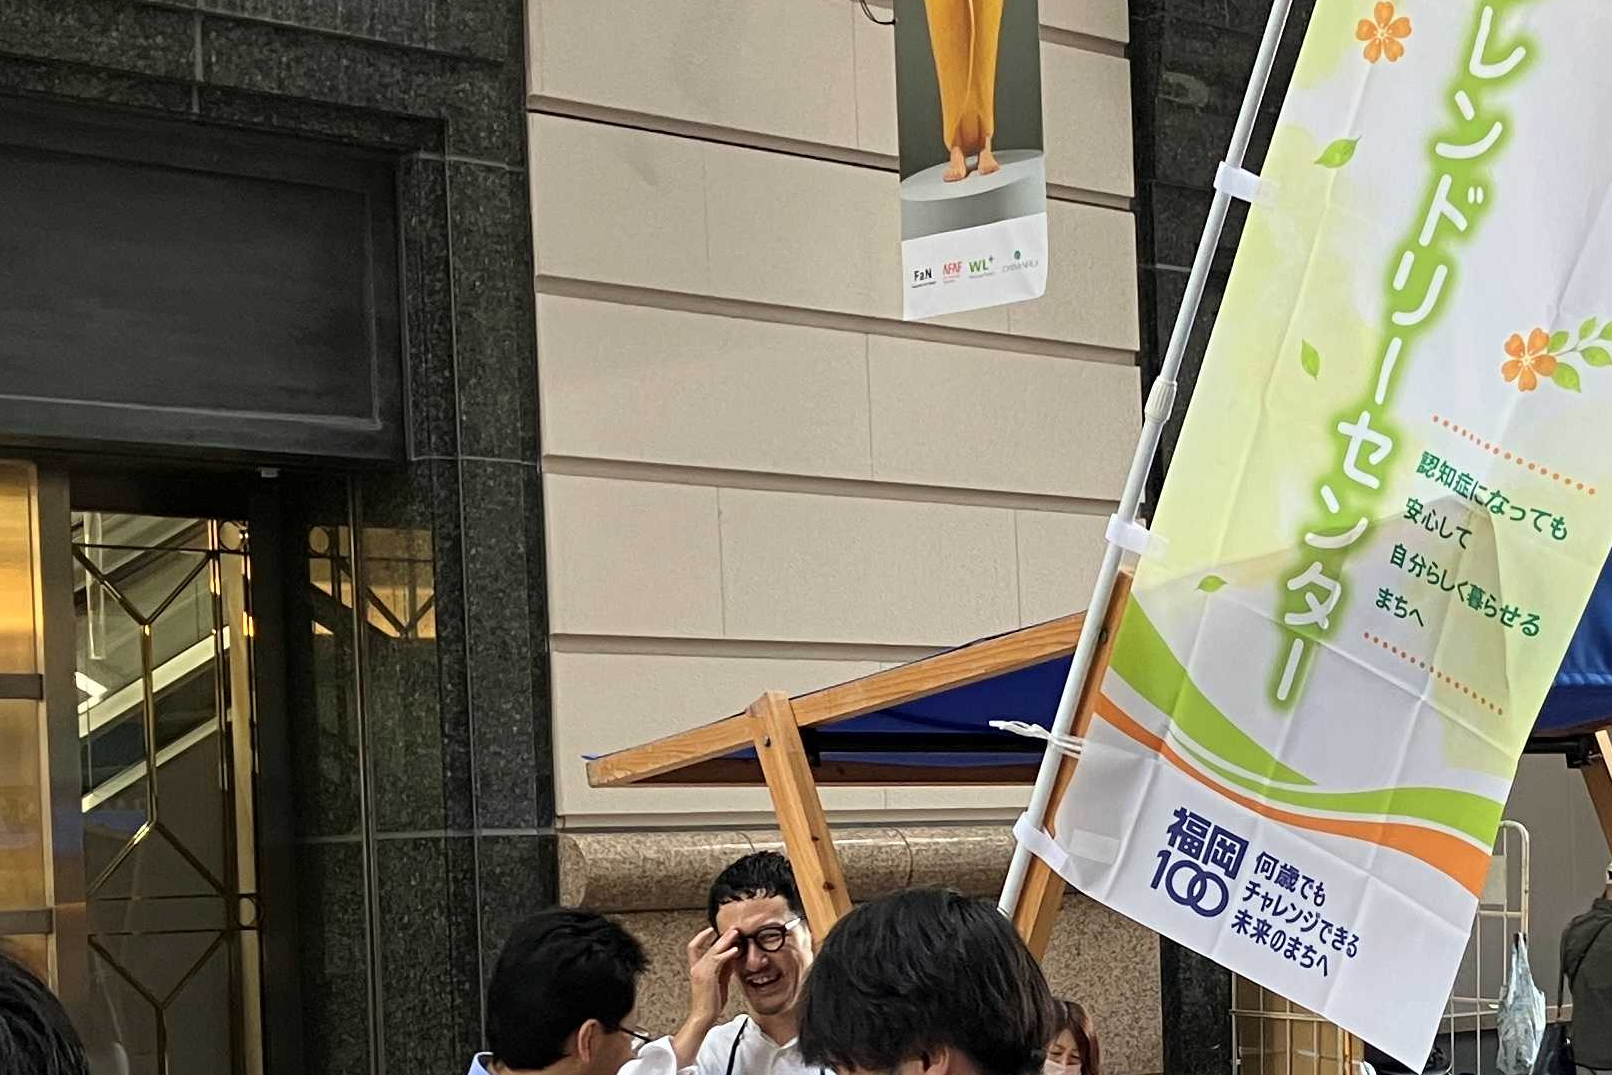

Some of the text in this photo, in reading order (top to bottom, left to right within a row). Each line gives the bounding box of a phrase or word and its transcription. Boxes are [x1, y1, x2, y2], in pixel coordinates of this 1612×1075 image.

[913, 267, 932, 282] FaN
[1403, 497, 1472, 549] 安心して
[1416, 451, 1568, 541] 認知症になっても
[1375, 587, 1425, 627] まちへ
[1390, 543, 1541, 636] 自分らしく暮らせる
[1167, 807, 1250, 881] 福岡
[1150, 849, 1229, 918] 100
[1253, 851, 1326, 907] 何歳でも
[1231, 909, 1328, 977] 未来のまちへ
[1242, 880, 1360, 958] チャレンジできる
